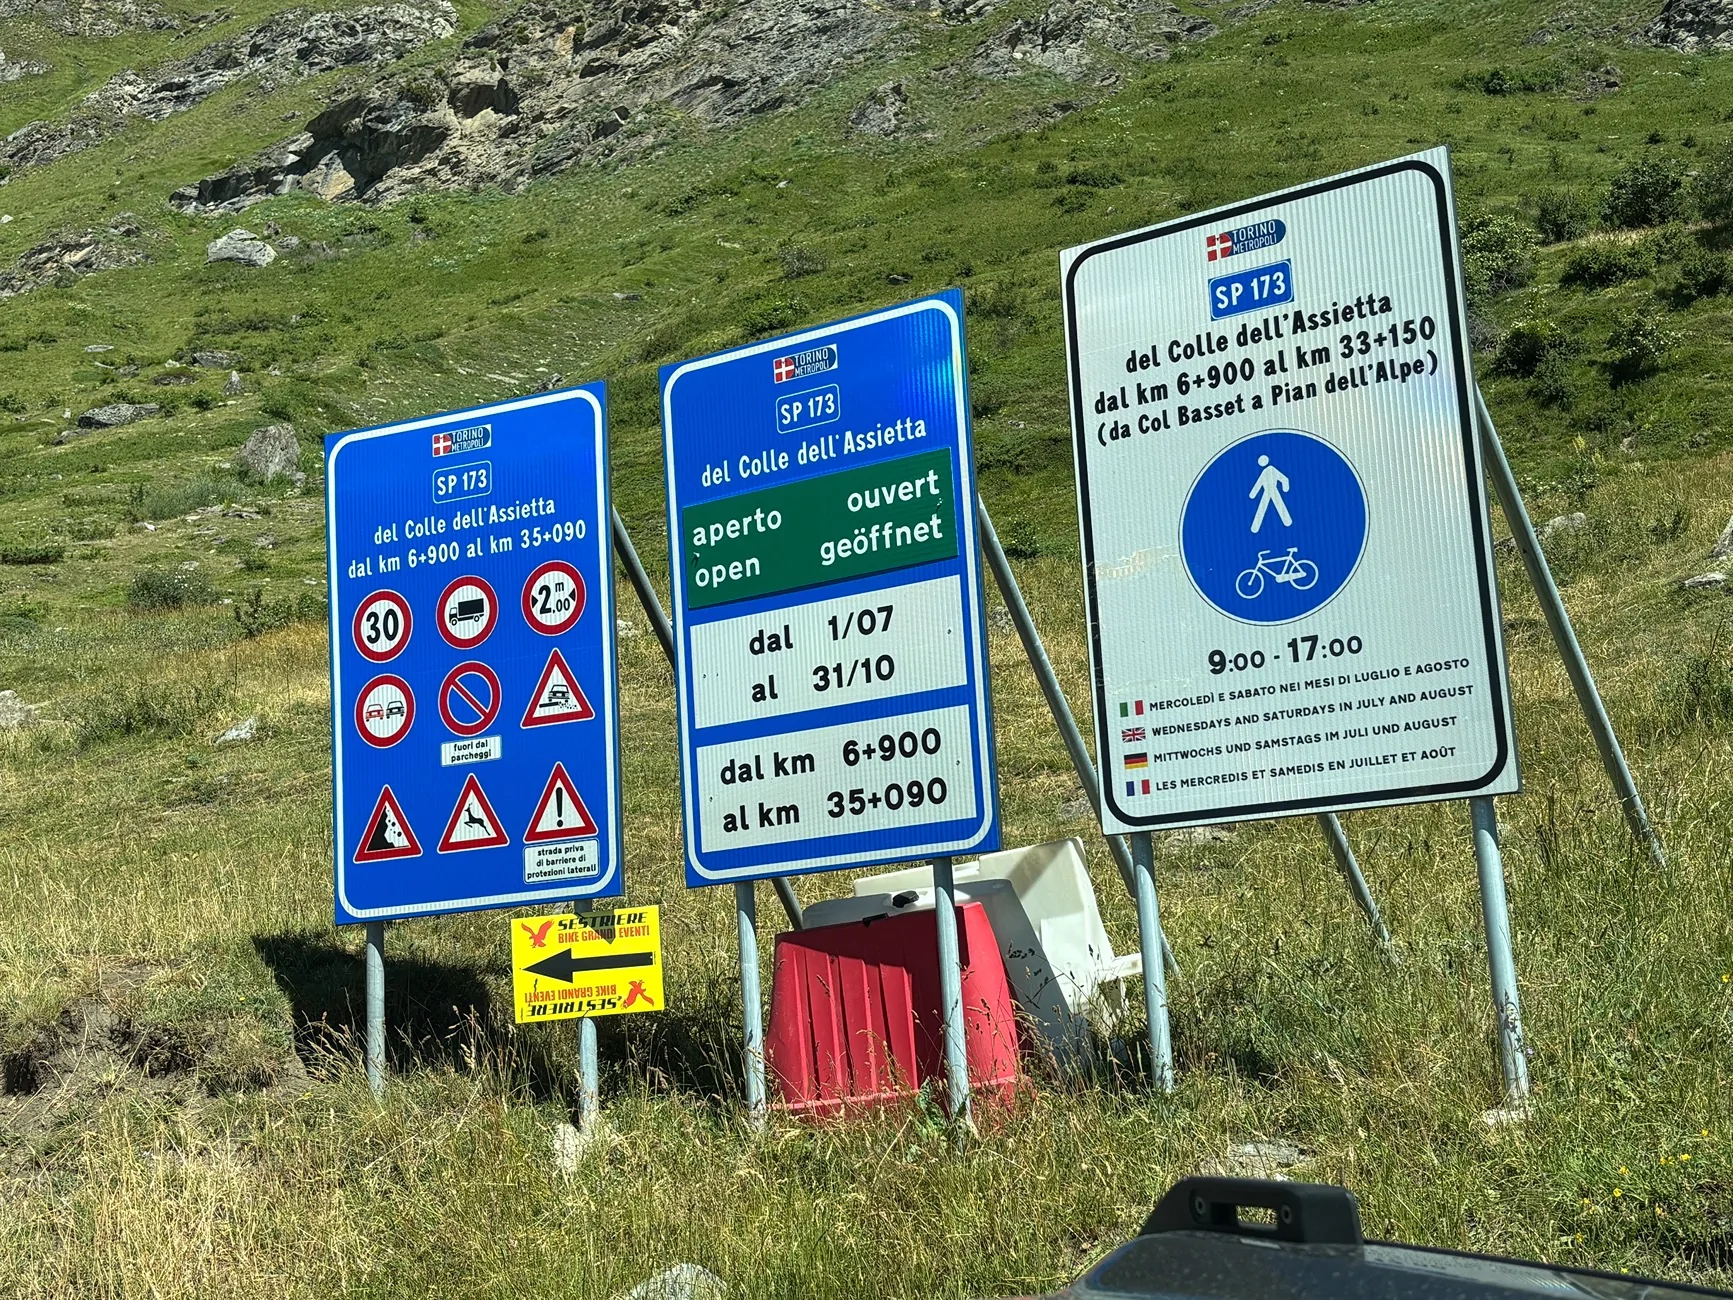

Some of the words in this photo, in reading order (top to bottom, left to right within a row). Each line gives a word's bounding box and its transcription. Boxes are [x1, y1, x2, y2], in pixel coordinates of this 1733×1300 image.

[1232, 220, 1276, 243] TORINO
[1233, 234, 1277, 254] METROPOLI
[1215, 283, 1243, 310] SP
[1250, 271, 1286, 301] 173
[1126, 345, 1160, 374] del
[1168, 333, 1229, 364] Colle
[1236, 293, 1392, 348] dell'Assietta
[795, 348, 828, 367] TORINO
[795, 360, 829, 376] METROPOLI
[1094, 386, 1129, 415] dal
[1137, 379, 1168, 406] km
[1177, 357, 1255, 396] 6+900
[1263, 354, 1288, 376] al
[1297, 346, 1330, 370] km
[1340, 315, 1435, 359] 33+150
[780, 402, 802, 425] SP
[808, 394, 835, 418] 173
[1098, 415, 1131, 447] (da
[1138, 405, 1171, 435] Col
[1178, 393, 1245, 427] Basset
[1251, 393, 1263, 410] a
[1271, 380, 1317, 406] Pian
[451, 437, 484, 452] METROPOLI
[452, 427, 483, 443] TORINO
[702, 463, 730, 487] del
[739, 450, 789, 478] Colle
[797, 417, 927, 465] dell'Assietta
[437, 476, 456, 496] SP
[462, 470, 487, 491] 173
[847, 470, 939, 512] ouvert
[374, 523, 398, 545] del
[405, 516, 446, 539] Colle
[452, 496, 555, 531] dell'Assietta
[693, 508, 782, 546] aperto
[348, 558, 372, 579] dal
[379, 553, 400, 573] km
[408, 542, 460, 568] 6+900
[466, 538, 483, 559] al
[490, 533, 512, 554] km
[520, 519, 586, 549] 35+090
[820, 513, 943, 565] geöffnet
[555, 582, 564, 593] m
[695, 557, 760, 587] open
[366, 608, 399, 644] 30
[749, 624, 794, 656] dal
[828, 604, 894, 641] 1/07
[1208, 649, 1265, 675] 9:00
[1287, 634, 1363, 664] 17:00
[751, 674, 778, 702] al
[812, 654, 895, 692] 31/10
[1149, 691, 1215, 712] MERCOLEDÌ
[1218, 692, 1225, 702] E
[1229, 685, 1276, 701] SABATO
[1279, 681, 1300, 694] NEI
[1304, 677, 1335, 691] MESI
[1338, 674, 1351, 685] DI
[1354, 667, 1400, 684] LUGLIO
[1404, 666, 1412, 676] E
[1415, 658, 1470, 674] AGOSTO
[1151, 718, 1232, 737] WEDNESDAYS
[1234, 713, 1260, 726] AND
[1263, 703, 1336, 723] SATURDAYS
[1339, 700, 1353, 711] IN
[1356, 696, 1386, 710] JULY
[1389, 692, 1417, 706] AND
[1419, 685, 1474, 702] AUGUST
[453, 741, 473, 752] fuori
[476, 740, 488, 748] dal
[1153, 745, 1223, 763] MITTWOCHS
[1225, 741, 1252, 755] UND
[1255, 733, 1322, 751] SAMSTAGS
[1325, 731, 1340, 742] IM
[1342, 727, 1369, 740] JULI
[1372, 723, 1400, 736] UND
[1403, 716, 1458, 732] AUGUST
[451, 749, 492, 763] parcheggi
[720, 754, 765, 785] dal
[773, 751, 815, 778] km
[842, 727, 941, 767] 6+900
[1155, 780, 1177, 791] LES
[1180, 771, 1249, 789] MERCREDIS
[1251, 769, 1266, 780] ET
[1269, 762, 1325, 778] SAMEDIS
[1328, 760, 1346, 771] EN
[1348, 753, 1398, 769] JUILLET
[1401, 752, 1417, 763] ET
[1420, 745, 1456, 760] AOÛT
[723, 805, 750, 833] al
[758, 802, 800, 828] km
[827, 777, 947, 818] 35+090
[536, 859, 544, 867] di
[546, 856, 577, 866] barriere
[578, 854, 586, 863] di
[537, 847, 562, 857] strada
[564, 845, 584, 854] priva
[527, 867, 566, 880] protezioni
[567, 864, 596, 874] laterali
[558, 912, 648, 931] SESTRIERE
[558, 931, 580, 944] BIKE
[581, 927, 616, 942] GRANDI
[618, 925, 650, 937] EVENTI
[524, 990, 555, 1003] EVENTI
[558, 986, 594, 1002] GRANDI
[595, 984, 617, 996] BIKE
[526, 998, 617, 1017] SESTRIERE
